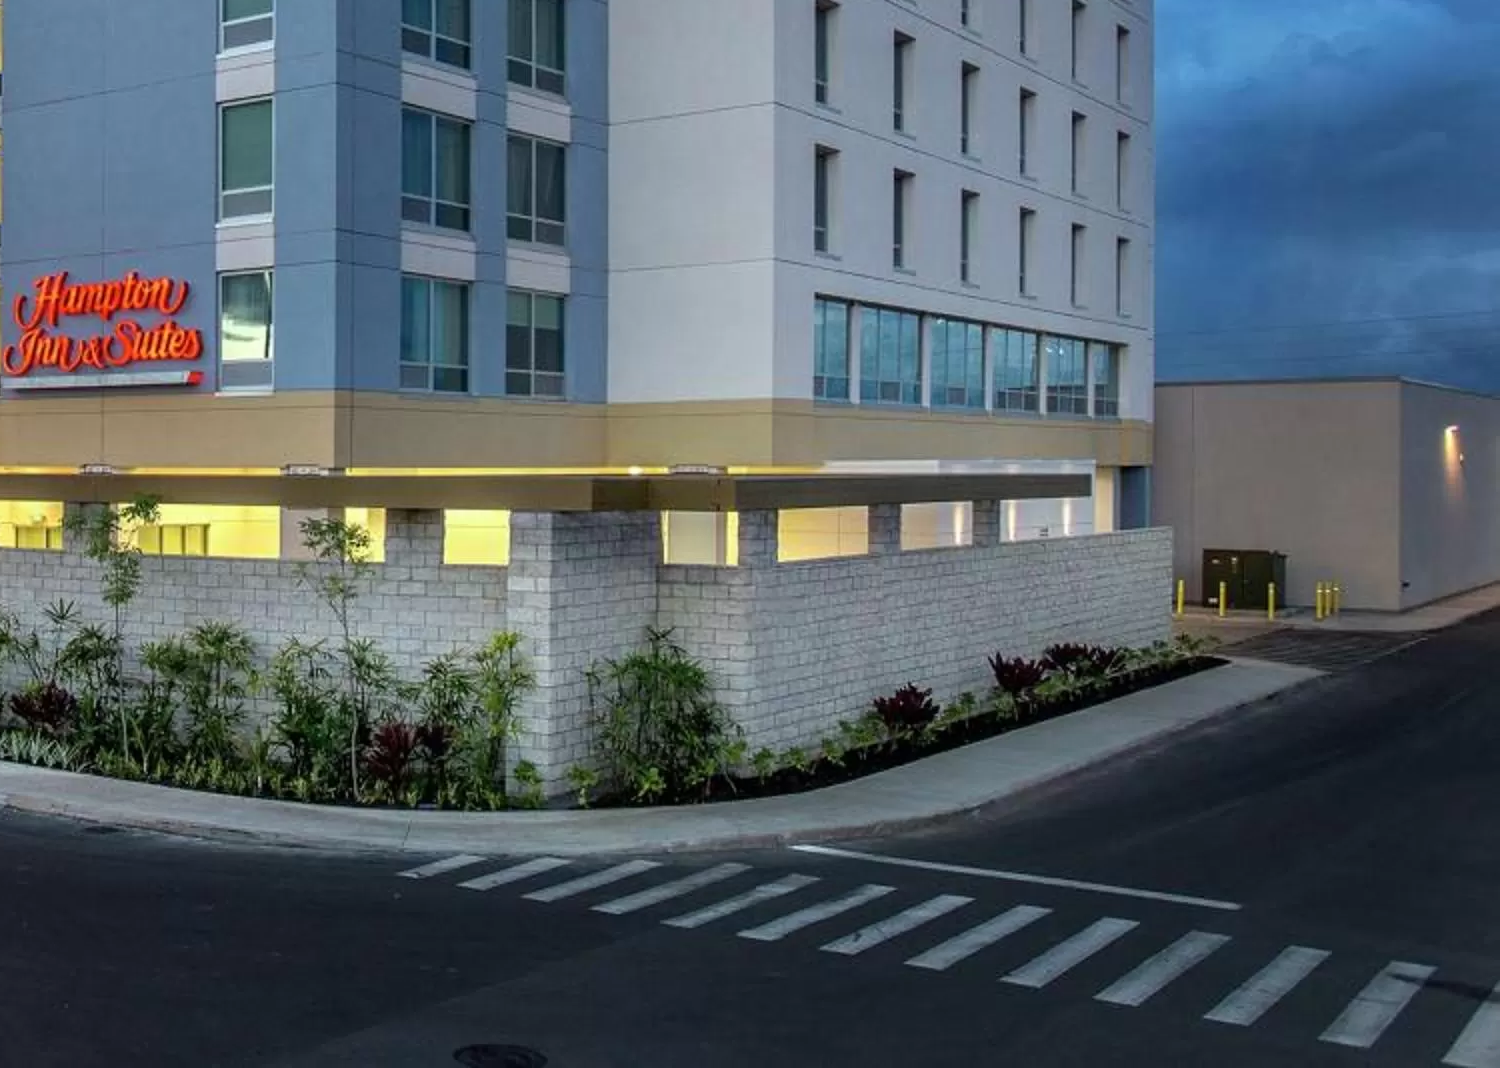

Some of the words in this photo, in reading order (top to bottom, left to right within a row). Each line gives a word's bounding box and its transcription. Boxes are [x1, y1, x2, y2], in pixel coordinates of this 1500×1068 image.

[14, 271, 190, 330] Hampton
[3, 329, 82, 376] Inn
[104, 319, 204, 366] Suites
